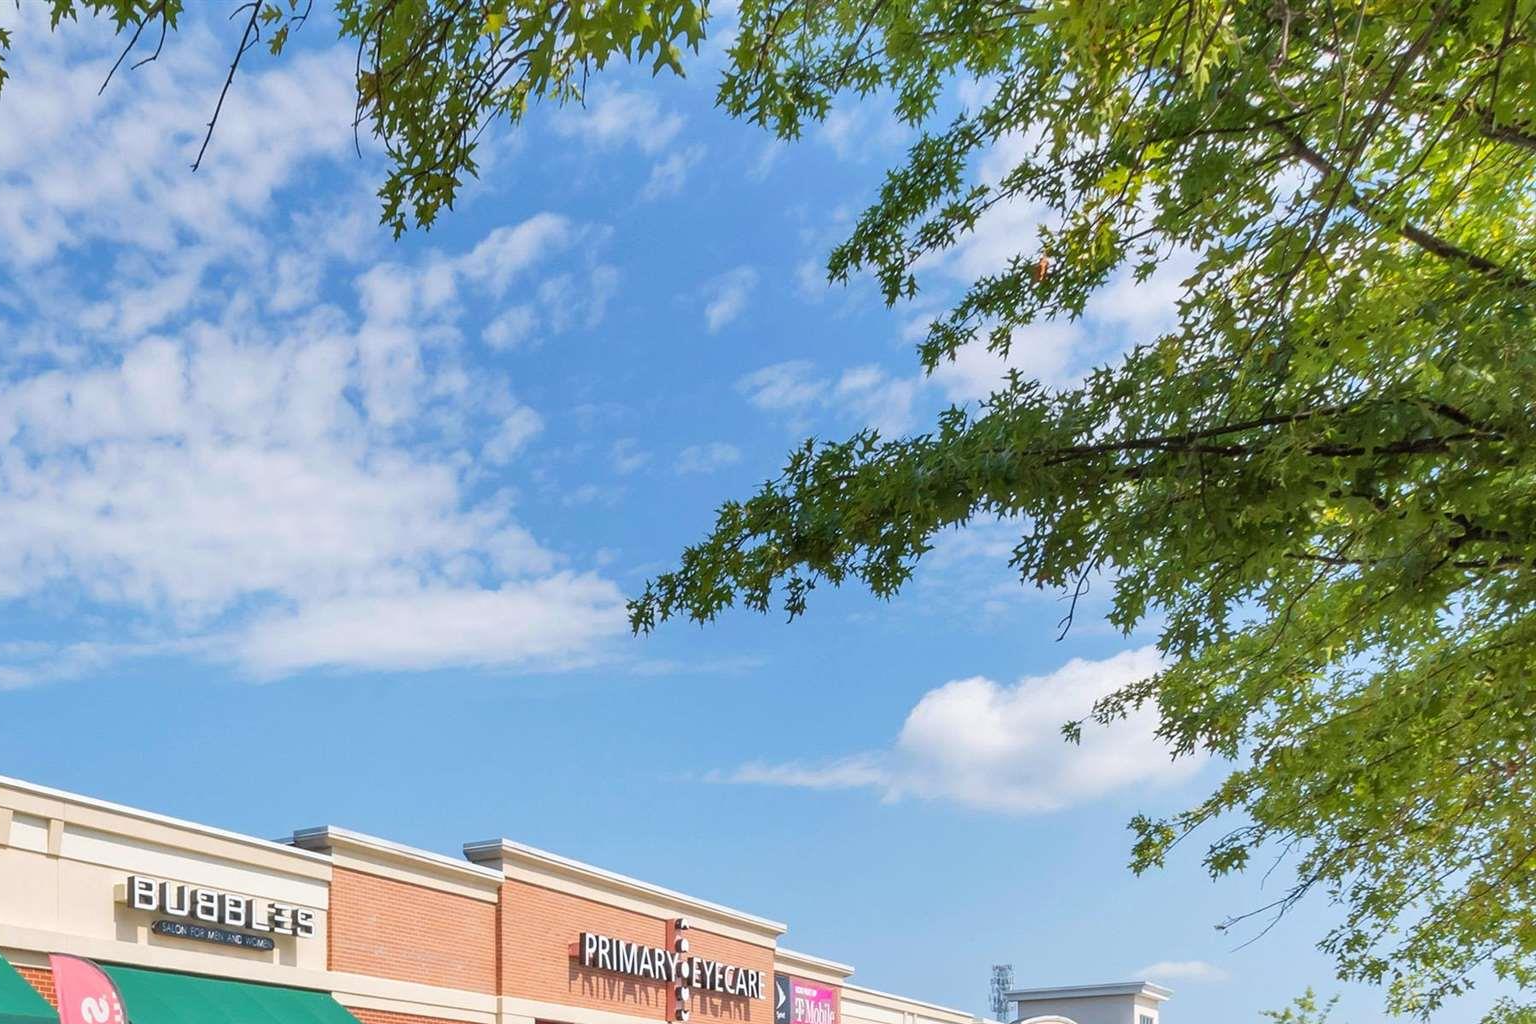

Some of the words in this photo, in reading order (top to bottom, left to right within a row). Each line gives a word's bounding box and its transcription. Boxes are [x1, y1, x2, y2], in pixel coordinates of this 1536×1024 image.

[129, 875, 315, 938] BUBBLES
[162, 921, 187, 935] SALON
[190, 927, 205, 938] FOR
[207, 931, 224, 941] MEN
[227, 934, 243, 945] AND
[245, 937, 273, 949] WOMEN
[582, 932, 679, 982] PRIMARY
[690, 957, 767, 1000] EYECARE
